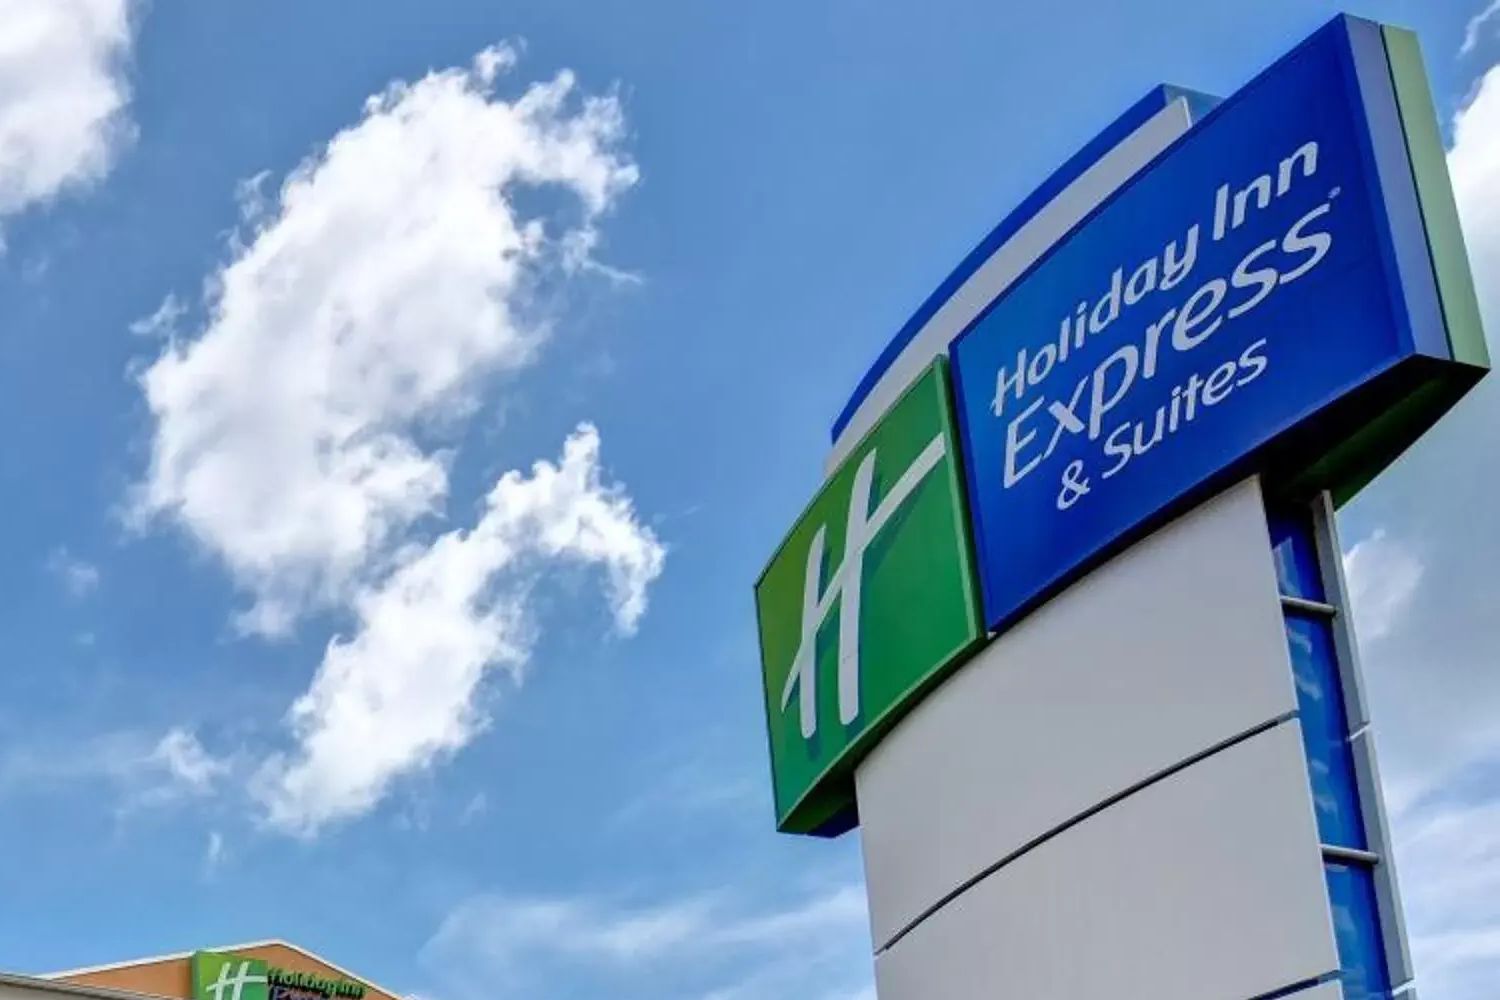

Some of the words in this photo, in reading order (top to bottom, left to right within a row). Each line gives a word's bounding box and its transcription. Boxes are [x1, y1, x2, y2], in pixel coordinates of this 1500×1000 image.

[991, 223, 1199, 417] Holiday
[1213, 141, 1318, 241] Inn
[1003, 203, 1332, 488] Express
[1057, 460, 1090, 510] &
[1102, 339, 1268, 480] Suites
